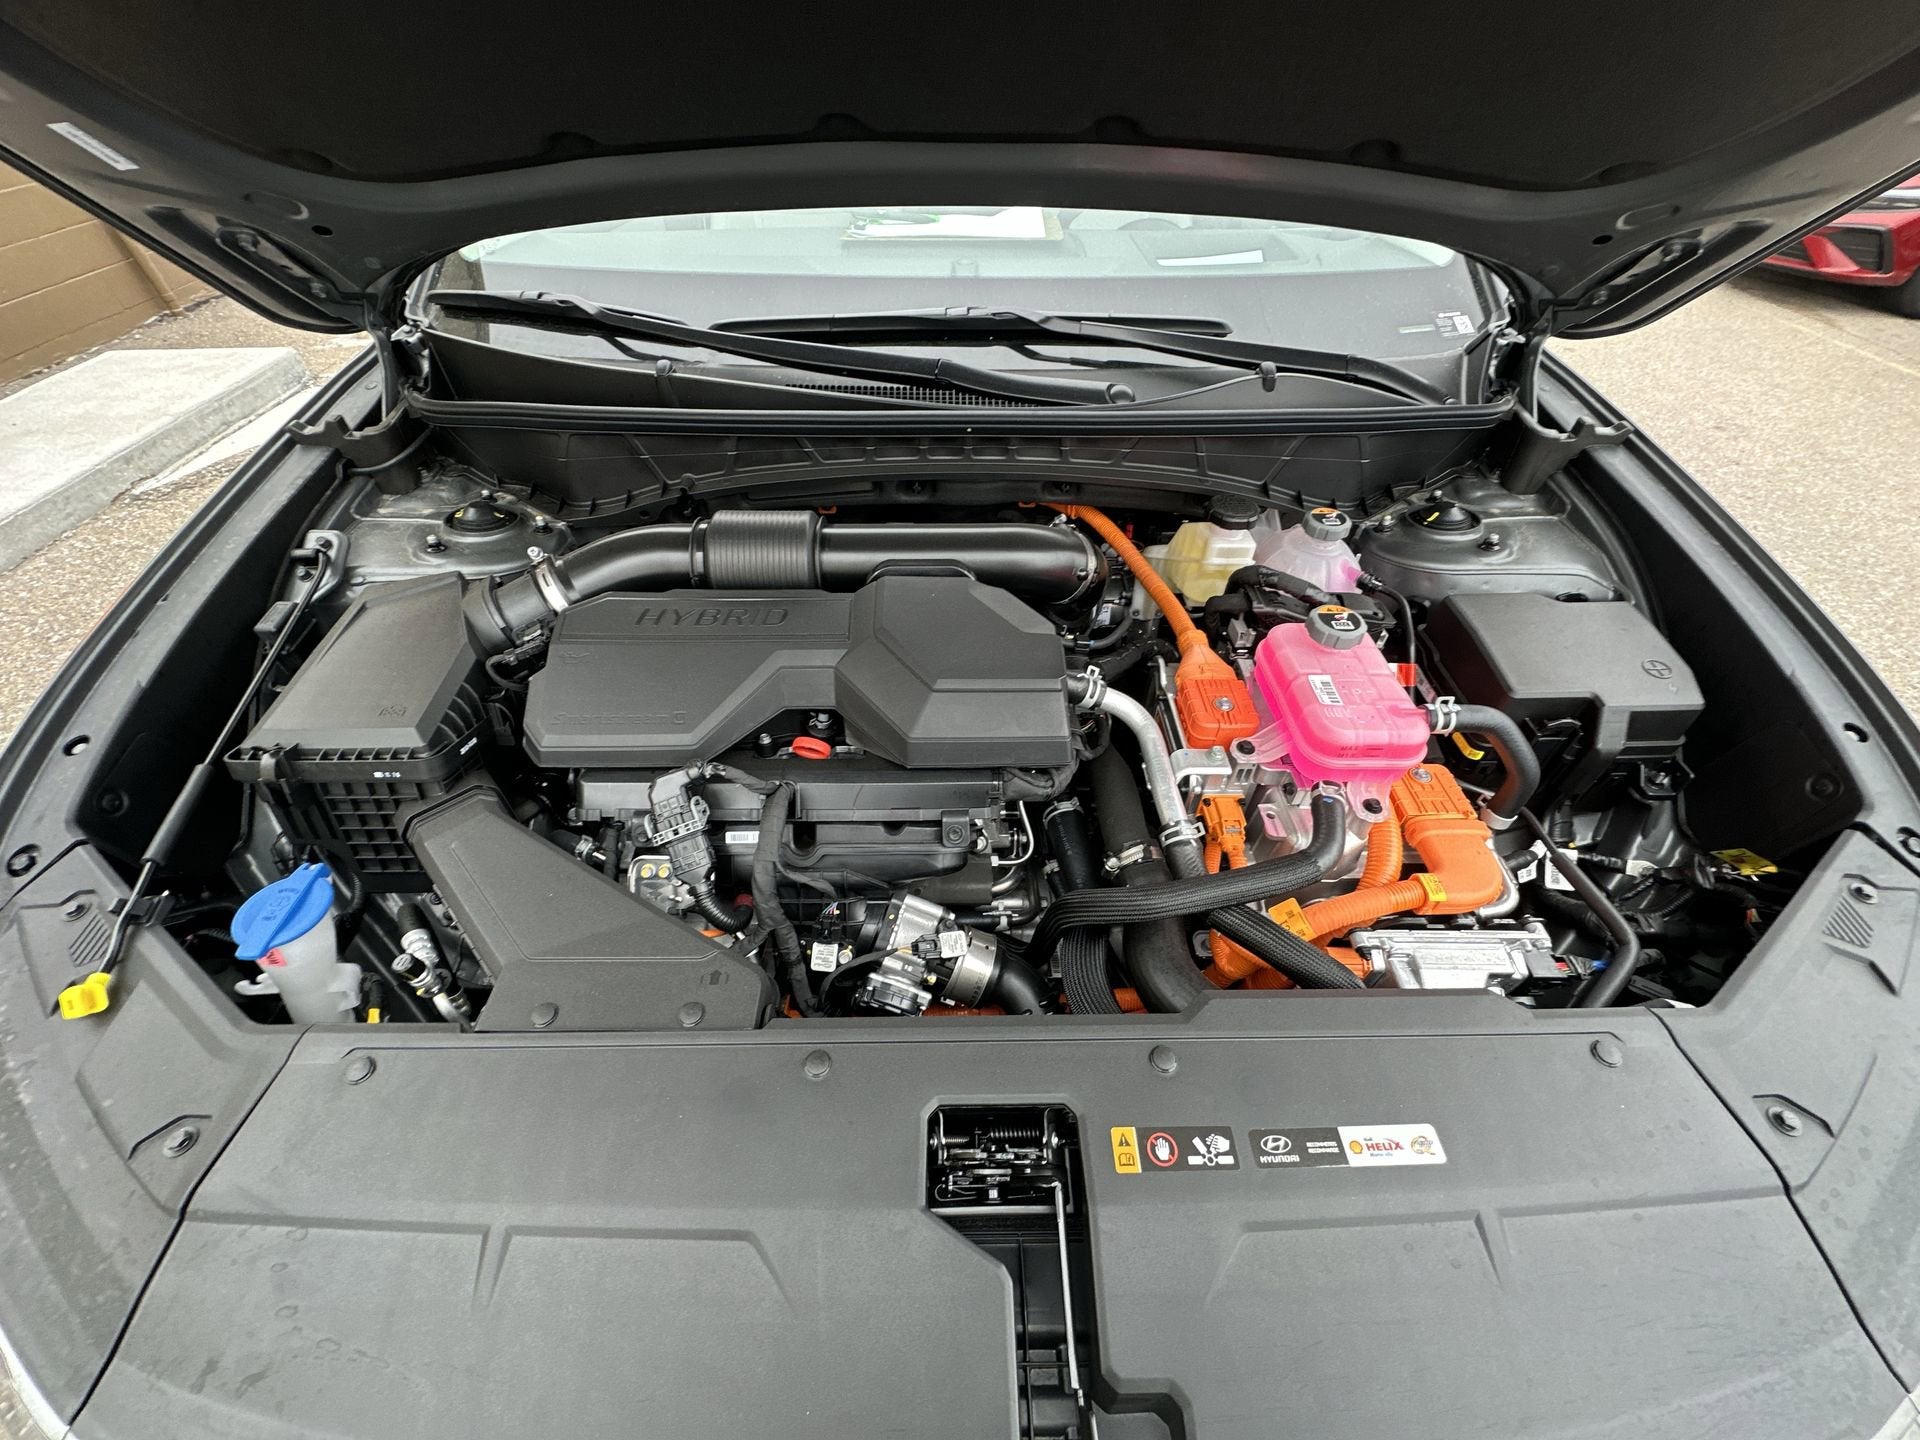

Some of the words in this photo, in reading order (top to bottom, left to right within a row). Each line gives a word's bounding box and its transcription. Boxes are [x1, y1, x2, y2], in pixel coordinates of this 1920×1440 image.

[634, 607, 789, 627] HYBRID
[1365, 1140, 1405, 1152] HELIX
[1259, 1154, 1301, 1164] HYUNDAI
